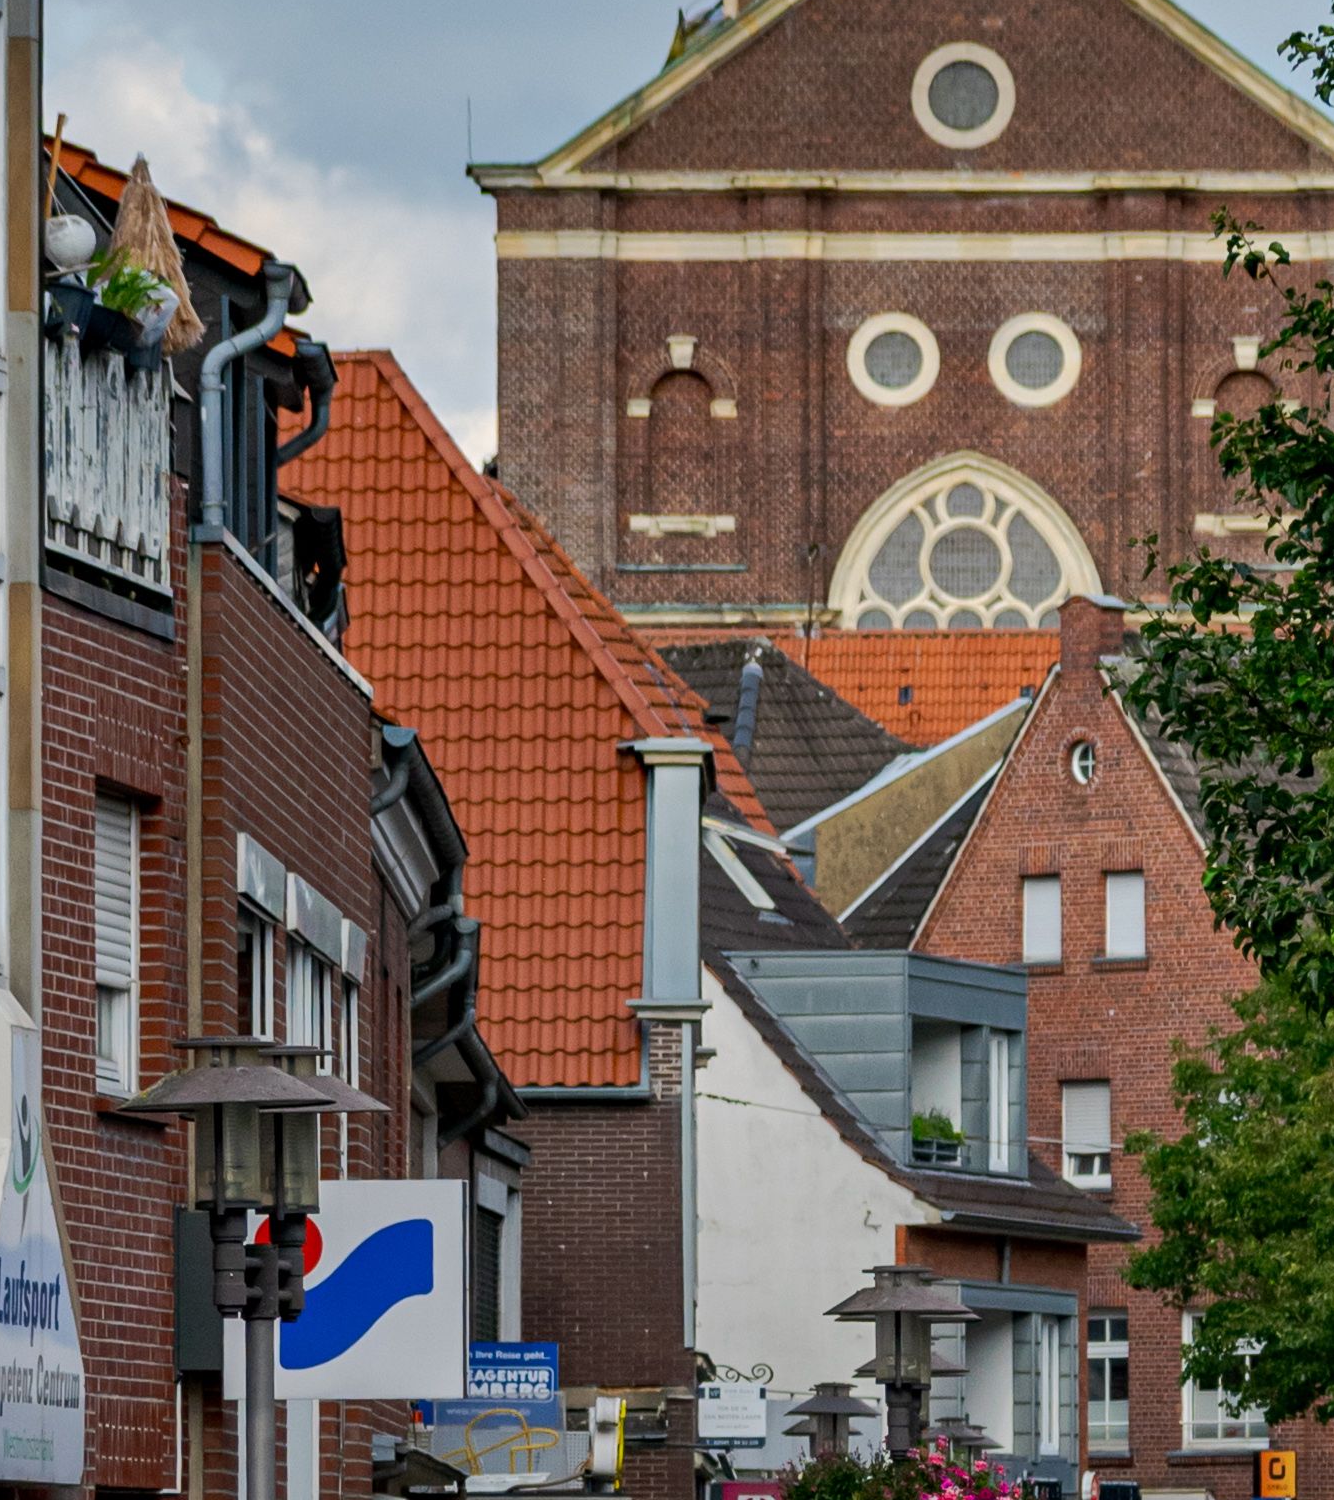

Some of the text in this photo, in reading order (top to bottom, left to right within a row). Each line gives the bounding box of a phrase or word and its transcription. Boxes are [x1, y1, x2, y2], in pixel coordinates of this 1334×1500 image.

[495, 1350, 521, 1359] Reise
[35, 1354, 81, 1409] Centrum
[469, 1382, 551, 1400] MBERG
